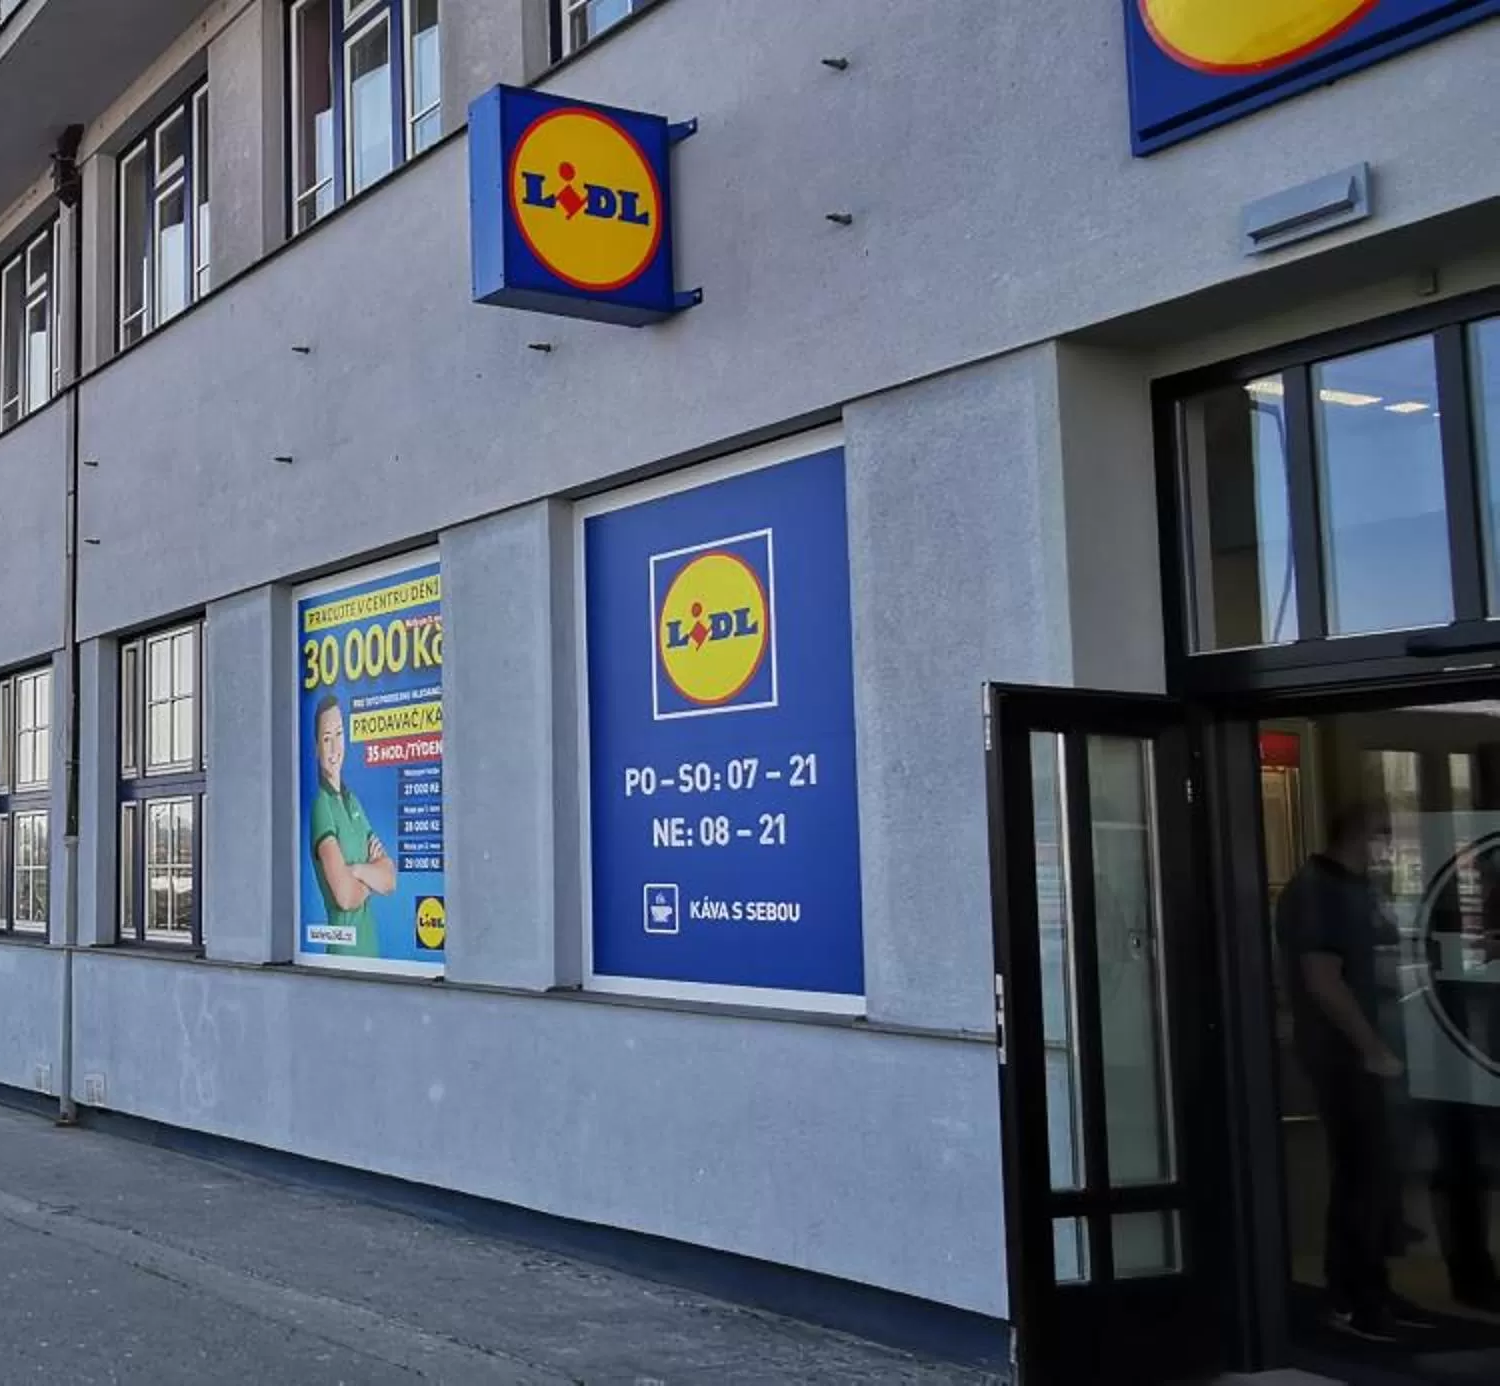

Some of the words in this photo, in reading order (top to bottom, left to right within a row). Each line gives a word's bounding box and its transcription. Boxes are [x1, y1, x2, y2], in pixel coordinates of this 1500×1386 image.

[304, 635, 339, 689] 30
[344, 619, 408, 680] 000
[367, 745, 380, 762] 35
[625, 767, 656, 797] PO
[678, 763, 721, 793] SO:
[727, 758, 759, 790] 07
[789, 753, 817, 787] 21
[653, 817, 694, 848] NE:
[700, 816, 730, 846] 08
[759, 813, 787, 845] 21
[690, 896, 730, 920] KÁVA
[731, 902, 743, 920] S
[746, 902, 800, 922] SEBOU
